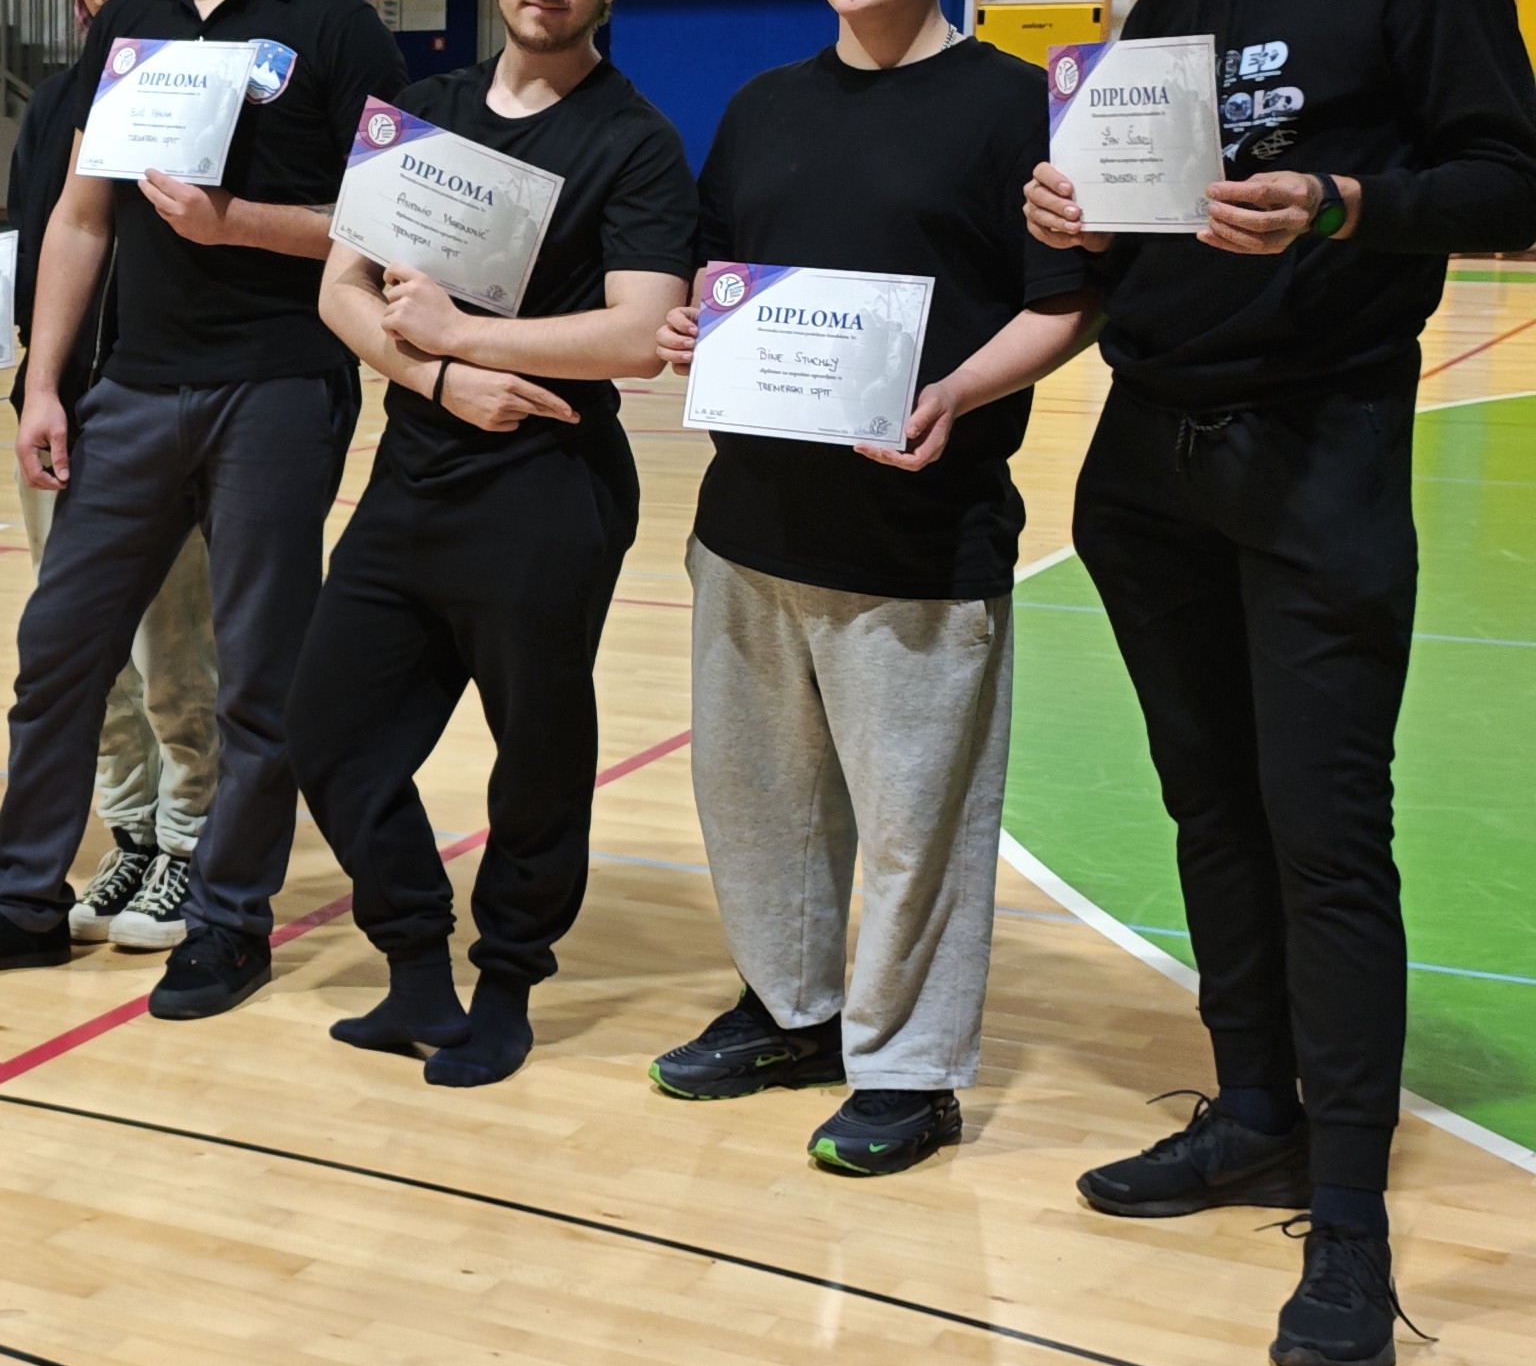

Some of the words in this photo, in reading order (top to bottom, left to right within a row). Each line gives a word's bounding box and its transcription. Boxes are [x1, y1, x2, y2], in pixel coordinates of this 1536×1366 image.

[138, 72, 208, 89] DIPLOMA
[1089, 86, 1170, 107] DIPLOMA
[400, 153, 495, 207] DIPLOMA
[755, 305, 865, 331] DIPLOMA
